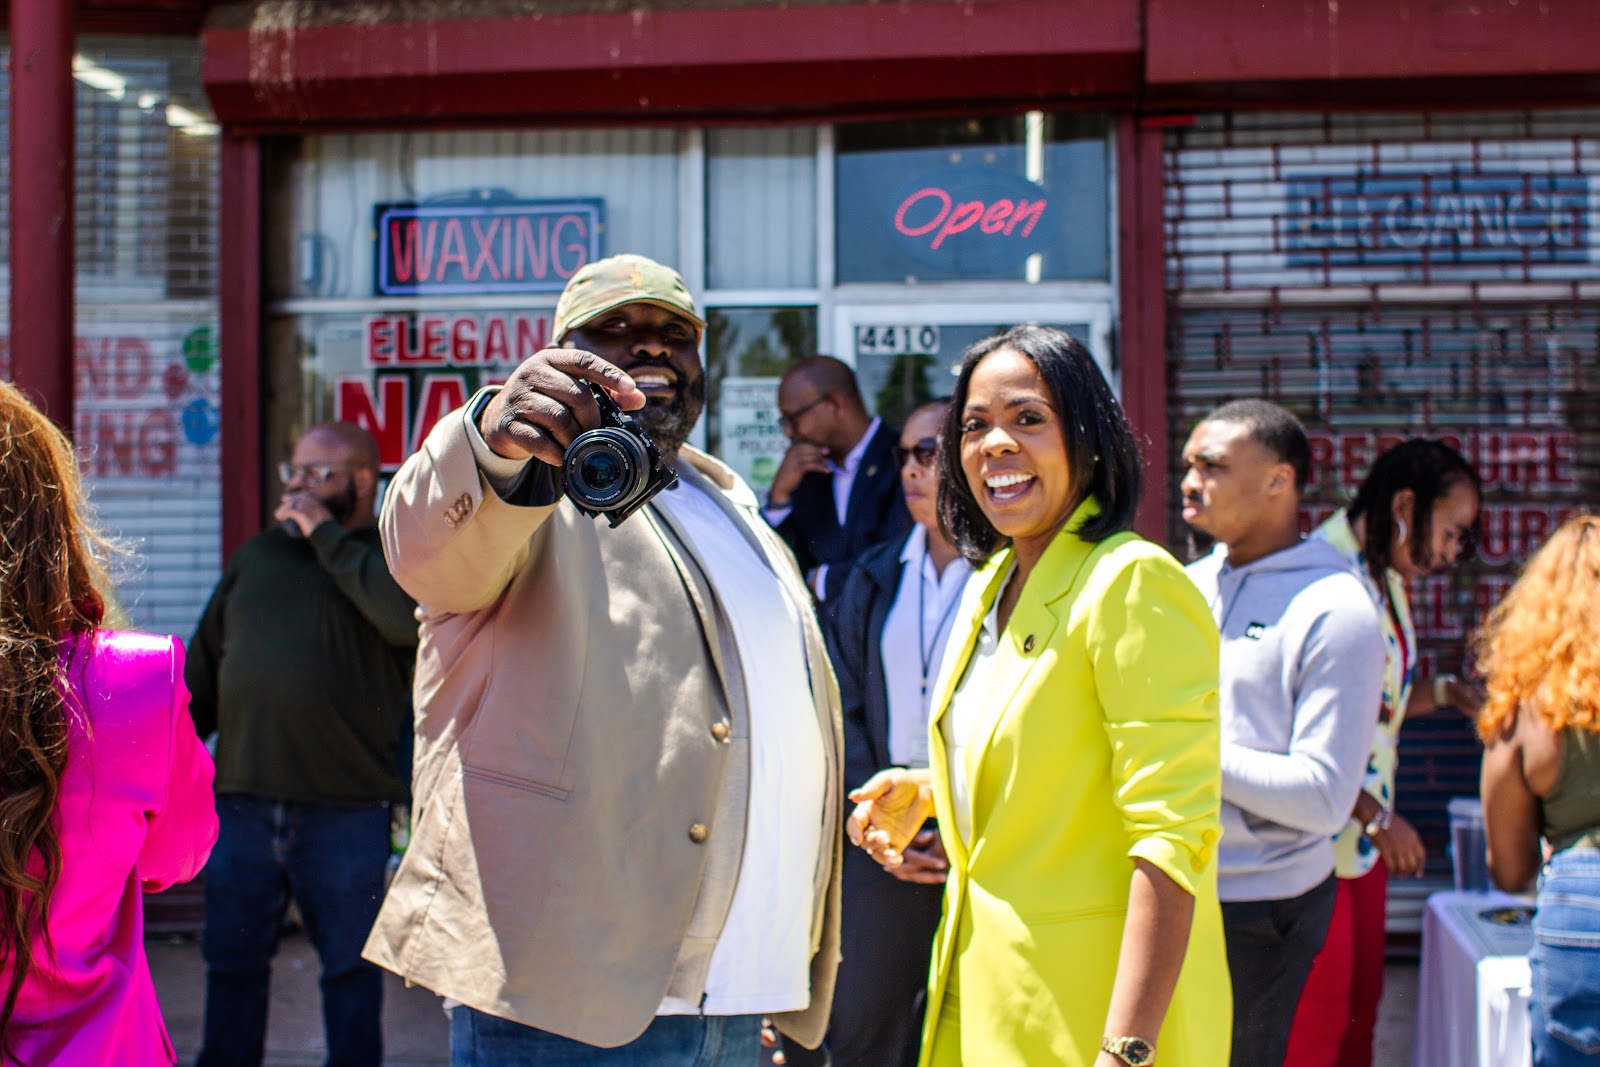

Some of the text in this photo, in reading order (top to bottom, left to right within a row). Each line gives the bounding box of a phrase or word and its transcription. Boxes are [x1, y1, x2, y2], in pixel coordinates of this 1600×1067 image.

[894, 187, 1048, 250] Open
[391, 214, 588, 282] WAXING
[365, 317, 548, 366] ELEGAN
[862, 326, 937, 350] 4410
[611, 411, 627, 429] SONY
[1302, 432, 1577, 489] PEURE
